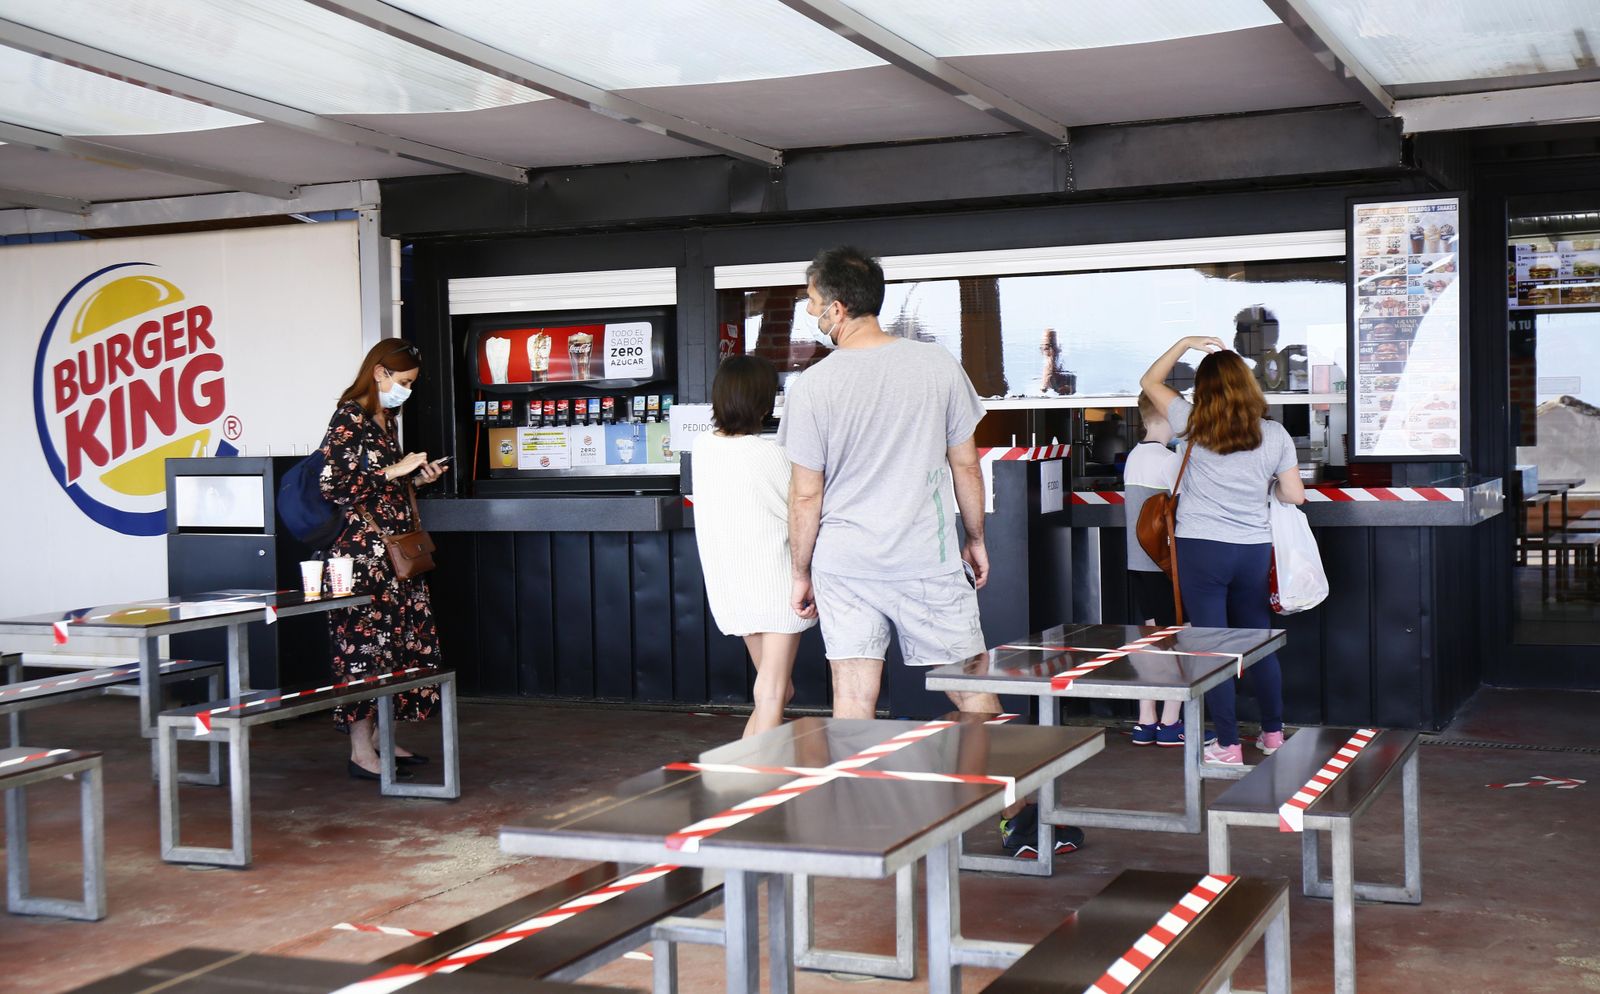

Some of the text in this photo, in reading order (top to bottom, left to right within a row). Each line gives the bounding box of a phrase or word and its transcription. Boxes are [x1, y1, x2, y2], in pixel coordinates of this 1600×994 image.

[610, 337, 644, 346] SABOR
[1519, 320, 1531, 330] TU
[53, 305, 216, 414] BURGER
[63, 353, 226, 487] KING
